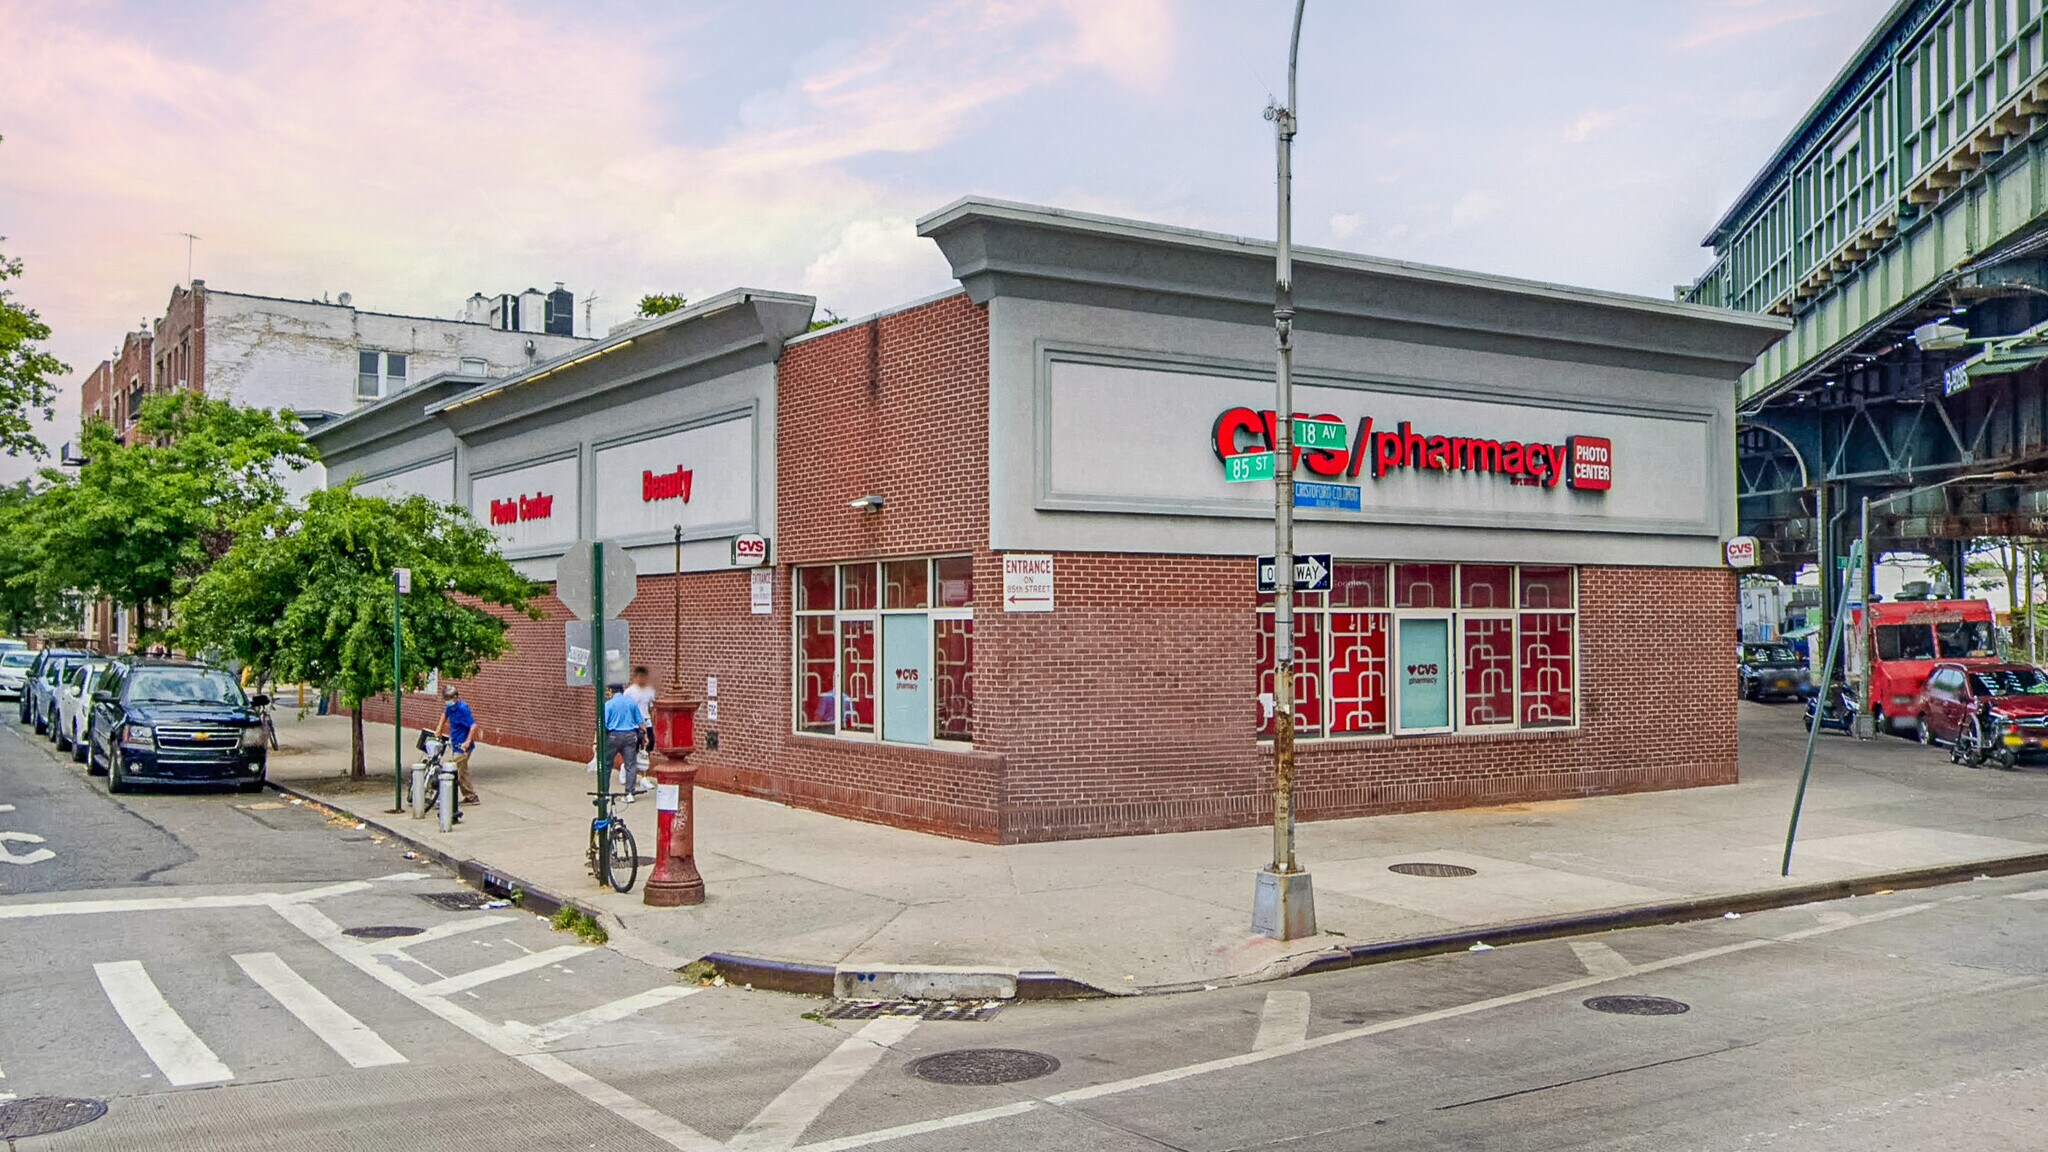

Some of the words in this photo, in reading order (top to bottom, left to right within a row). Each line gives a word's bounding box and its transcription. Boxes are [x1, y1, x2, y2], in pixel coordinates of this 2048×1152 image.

[1302, 423, 1316, 444] 18
[1322, 426, 1337, 440] AV
[1576, 445, 1608, 462] PHOTO
[1233, 458, 1250, 479] 85
[1256, 456, 1268, 471] ST
[1574, 465, 1610, 480] CENTER
[643, 464, 693, 504] Beauty
[490, 497, 518, 526] Photo
[519, 491, 553, 522] Center
[737, 540, 764, 552] CVS
[1729, 543, 1752, 554] CVS
[1006, 560, 1051, 574] ENTRANCE
[1296, 566, 1319, 580] WAY
[1024, 576, 1034, 584] ON
[1025, 585, 1050, 593] STREET
[903, 668, 919, 680] CVS
[1417, 664, 1438, 675] CVS
[896, 682, 918, 691] pharmacy
[1408, 677, 1437, 685] pharmacy
